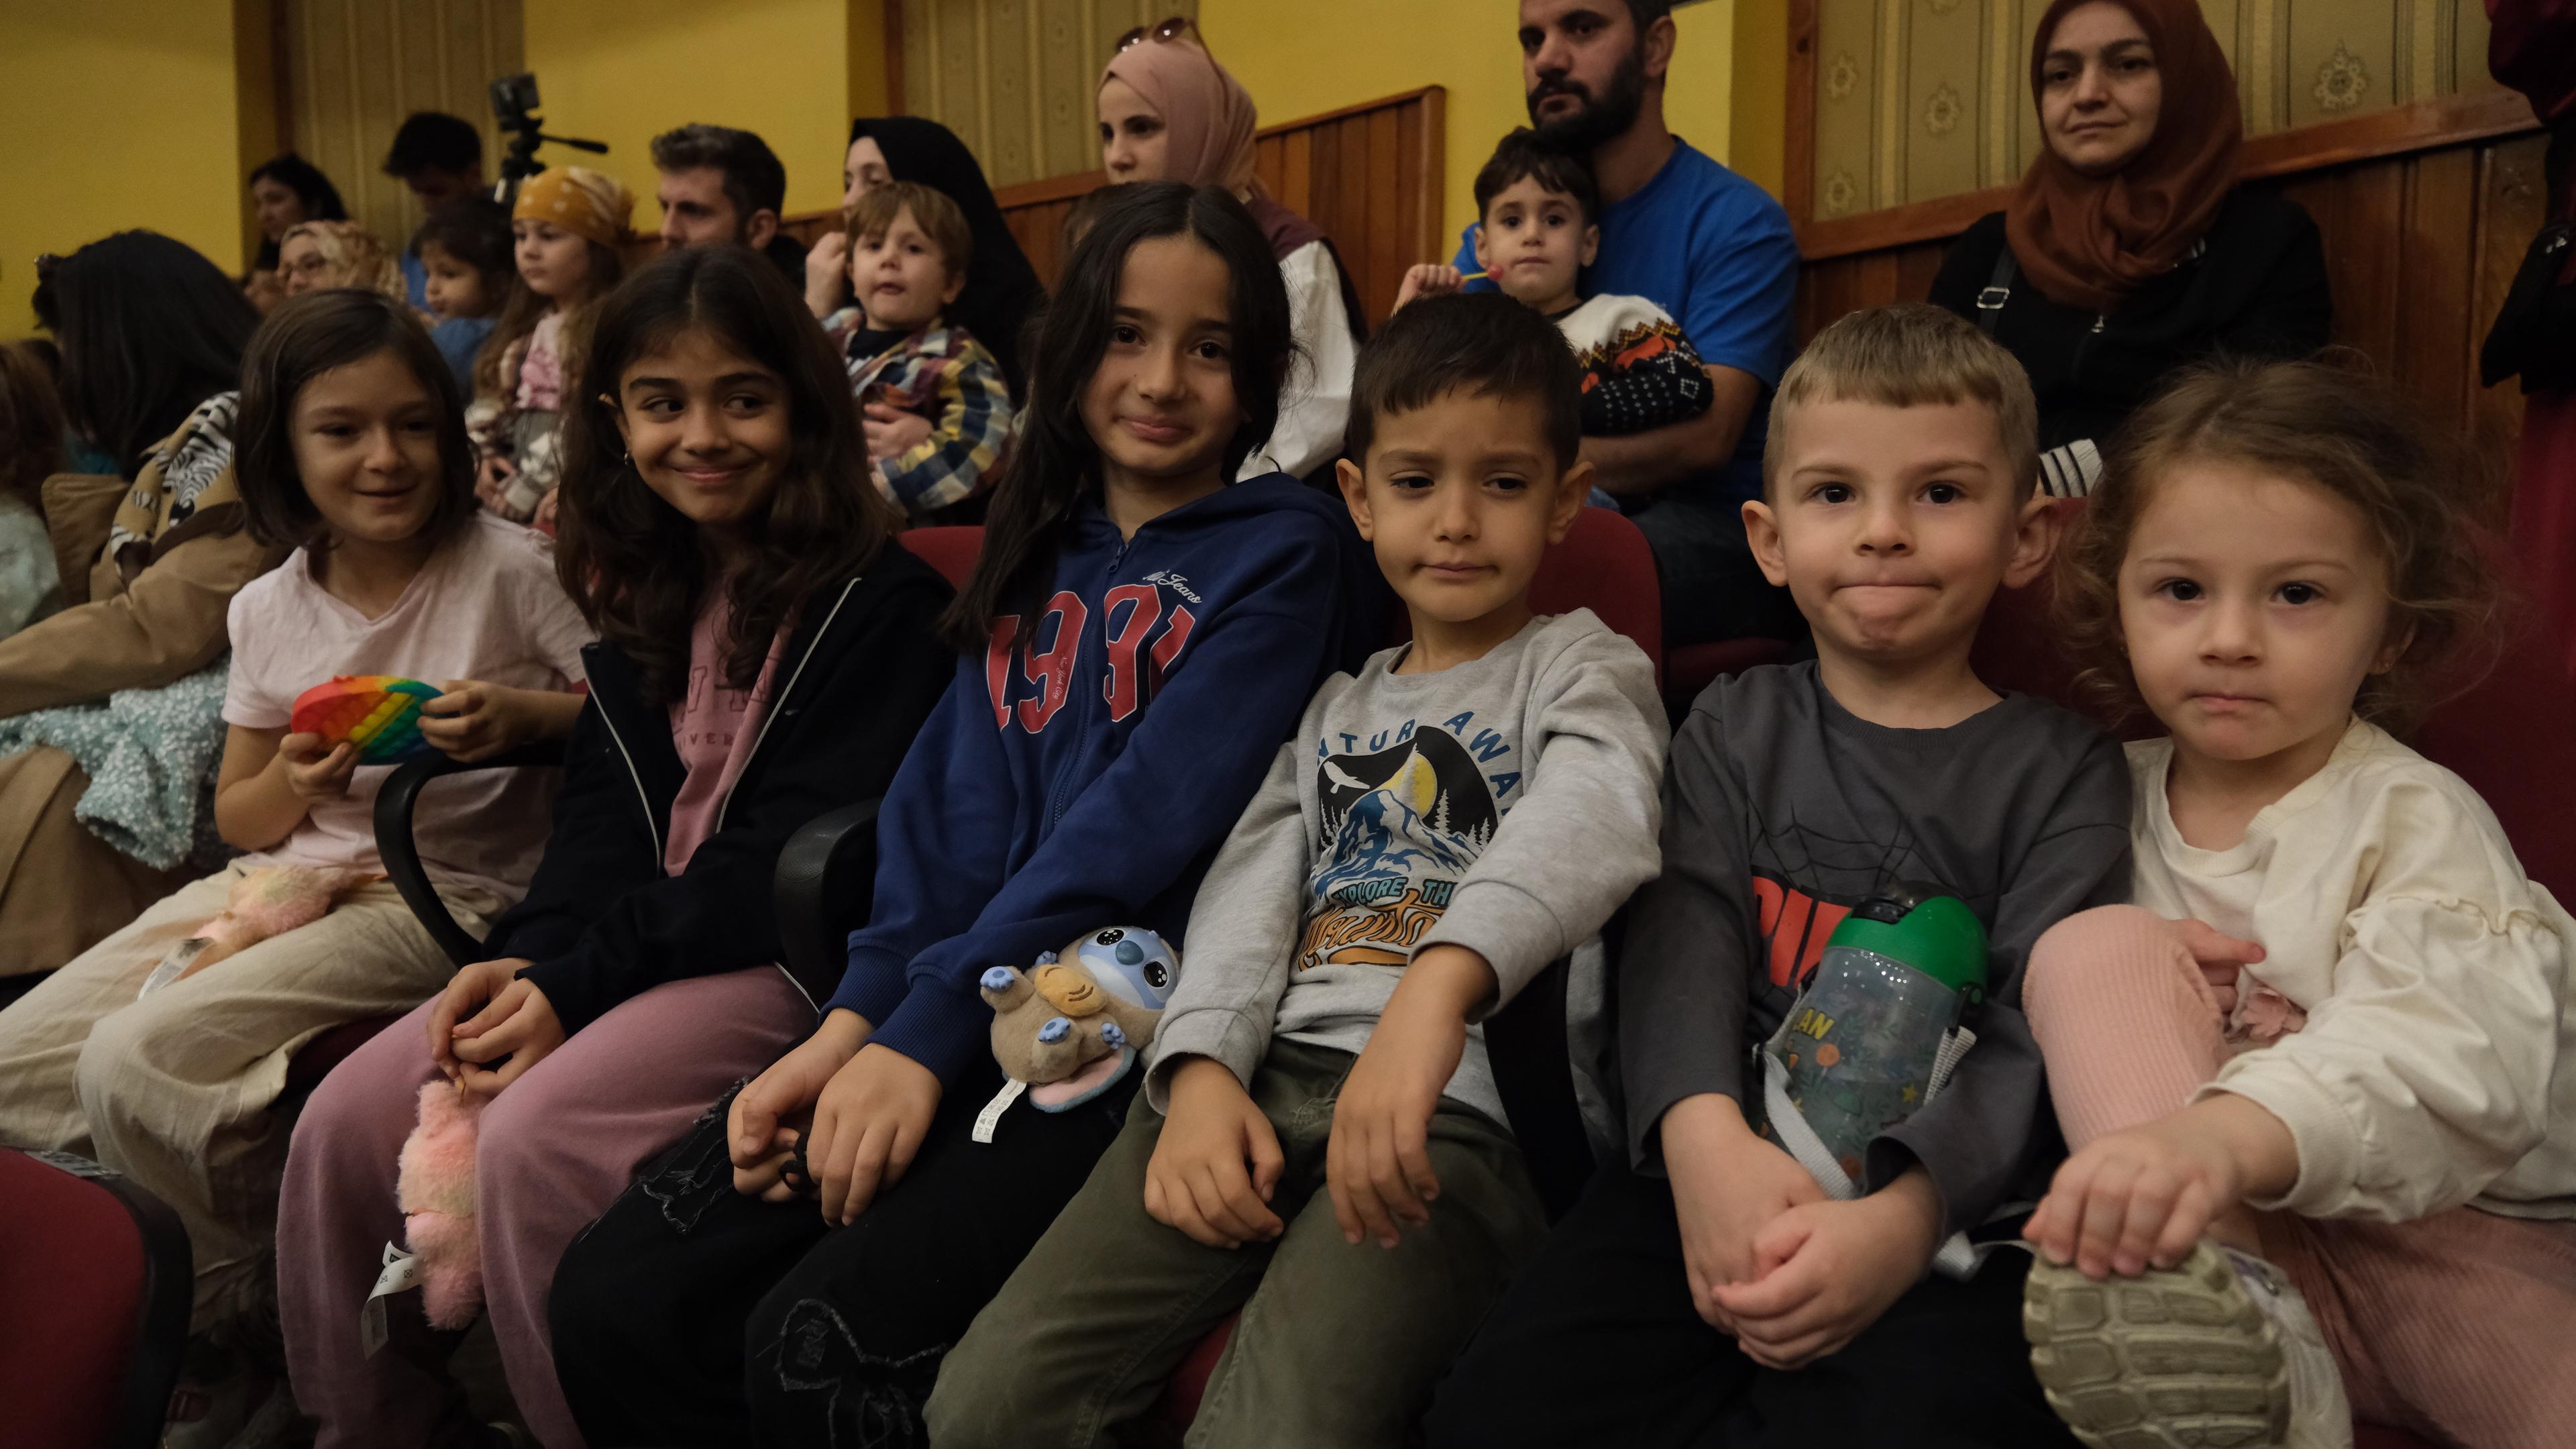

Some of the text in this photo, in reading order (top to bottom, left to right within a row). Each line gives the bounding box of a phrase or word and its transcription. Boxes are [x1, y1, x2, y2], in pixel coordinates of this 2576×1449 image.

[1157, 574, 1202, 603] Jeans
[1056, 667, 1066, 686] York
[1052, 686, 1064, 699] City
[1443, 711, 1521, 816] AWA
[1331, 877, 1458, 908] XPLORE TH
